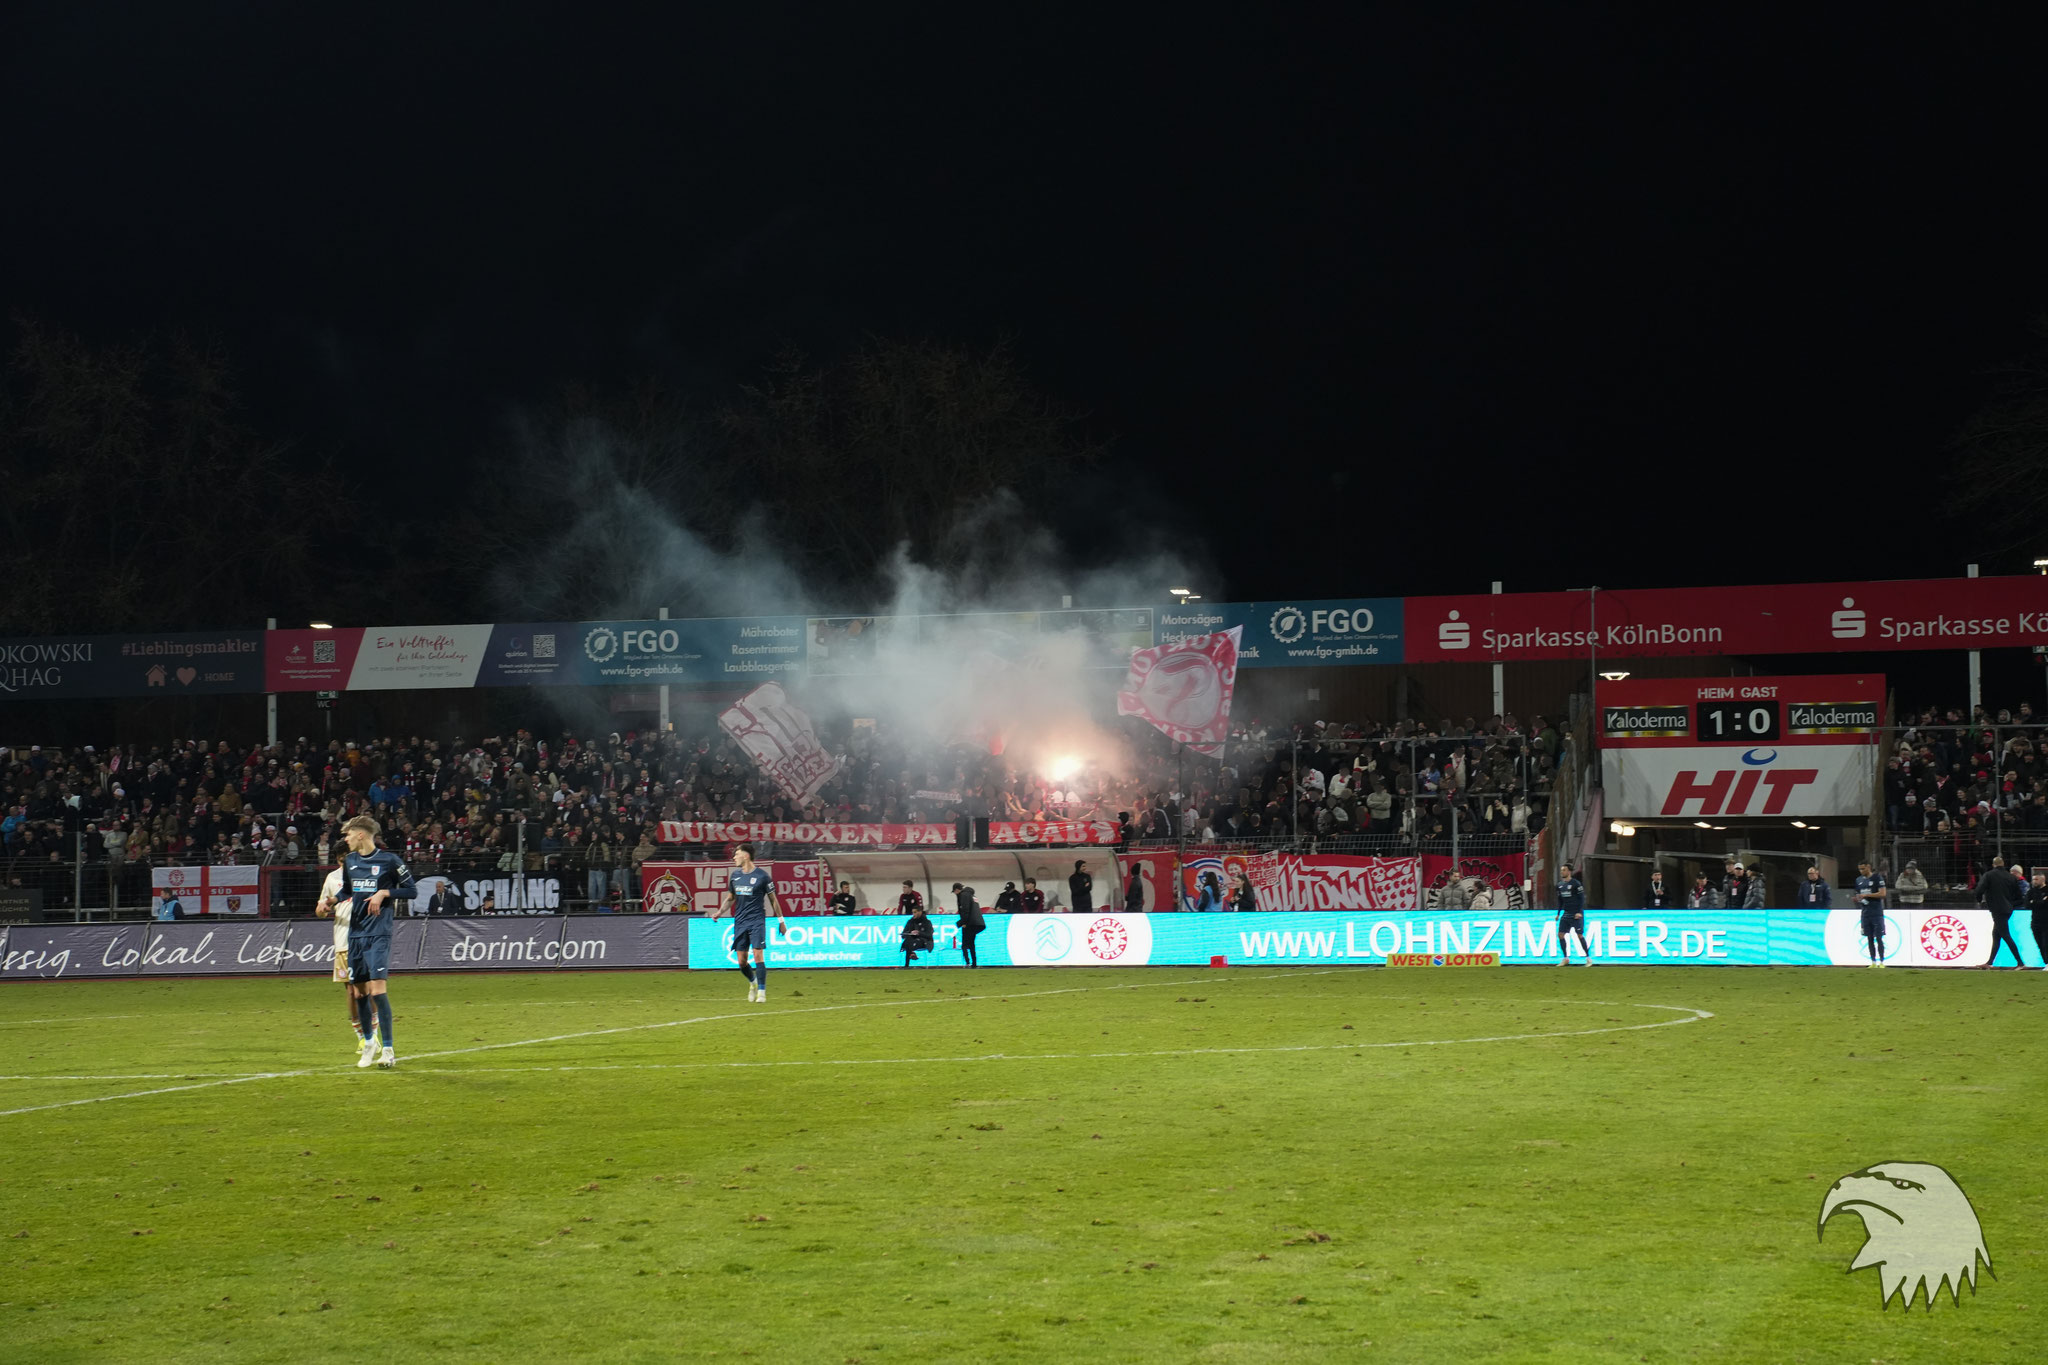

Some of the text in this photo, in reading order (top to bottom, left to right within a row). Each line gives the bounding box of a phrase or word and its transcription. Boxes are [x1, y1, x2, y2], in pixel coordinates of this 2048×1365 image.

[1161, 614, 1223, 627] Motorsägen
[1312, 608, 1374, 633] FGO
[1880, 615, 2009, 642] Sparkasse
[623, 629, 680, 653] FGO
[741, 627, 799, 638] Mähroboter
[1482, 624, 1722, 653] Sparkasse KölnBonn
[122, 639, 257, 657] #Lieblingsmakler
[732, 645, 799, 656] Rasentrimmer
[1288, 645, 1378, 658] www.fgo-gmbh.de
[204, 672, 235, 681] HOME
[601, 664, 683, 678] www.fgo-gmbh.de
[724, 661, 800, 674] Laubblasgeräte
[1697, 686, 1778, 699] HEIM GAST
[317, 700, 331, 708] WC
[1607, 711, 1687, 729] Kaloderma
[1709, 708, 1771, 735] 1:0
[1791, 707, 1875, 726] Kaloderma
[1660, 769, 1818, 815] HIT
[662, 821, 883, 843] DURCHBOXEN
[993, 821, 1088, 843] ACAB
[172, 885, 233, 896] KÖLN SÜD
[463, 873, 560, 910] SCHÄNG
[777, 880, 819, 895] DEN
[770, 926, 962, 945] LOHNZIMER
[1091, 918, 1128, 944] FORTUNA
[1924, 915, 1969, 944] FORTUNA
[451, 935, 606, 961] dorint.com
[1240, 921, 1727, 957] WWW.LOHNZIMMER.DE
[0, 940, 80, 977] ssig.
[102, 932, 216, 967] Lokal.
[770, 951, 862, 962] Die Lohnabrechner
[1392, 954, 1493, 966] WEST LOTTO
[1930, 947, 1963, 960] KÖLN
